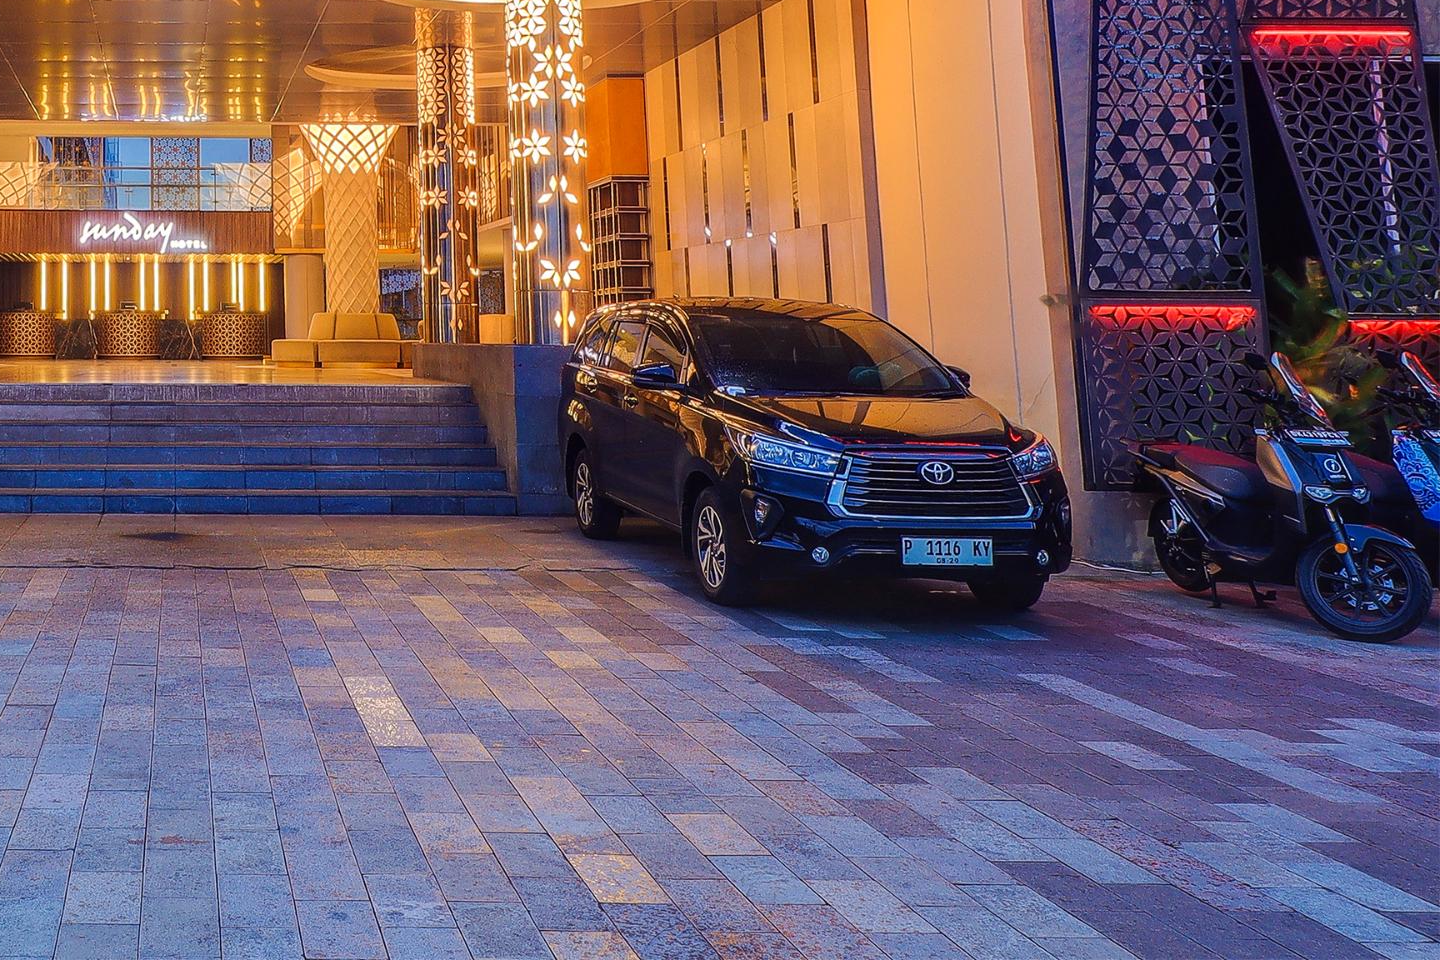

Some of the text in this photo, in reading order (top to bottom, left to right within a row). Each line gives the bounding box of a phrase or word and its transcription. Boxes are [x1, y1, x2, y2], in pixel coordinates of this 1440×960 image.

[79, 212, 174, 254] sunday
[903, 539, 991, 557] P 1116 KY
